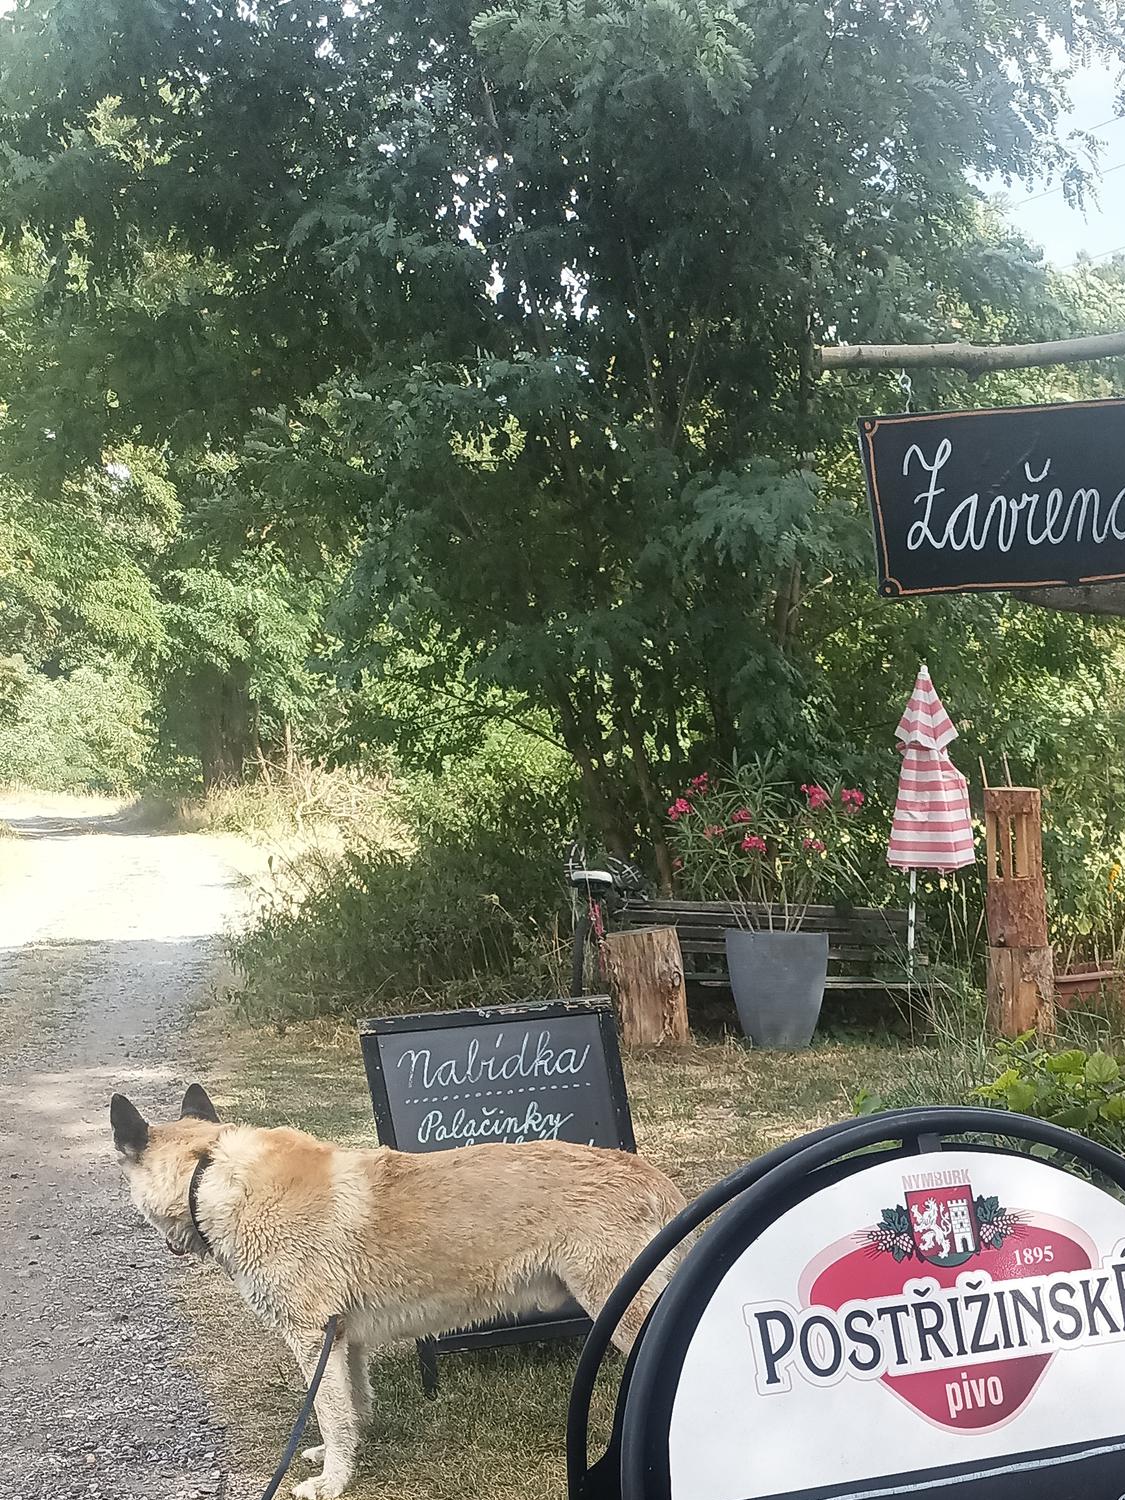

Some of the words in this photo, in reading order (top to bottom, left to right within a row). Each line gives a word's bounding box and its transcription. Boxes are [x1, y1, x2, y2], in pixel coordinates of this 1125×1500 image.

[396, 1030, 591, 1089] Nabídka
[416, 1101, 575, 1144] Palačinky
[901, 1168, 971, 1192] NYMBURK
[1013, 1244, 1055, 1267] 1895
[944, 1371, 1004, 1419] pivo
